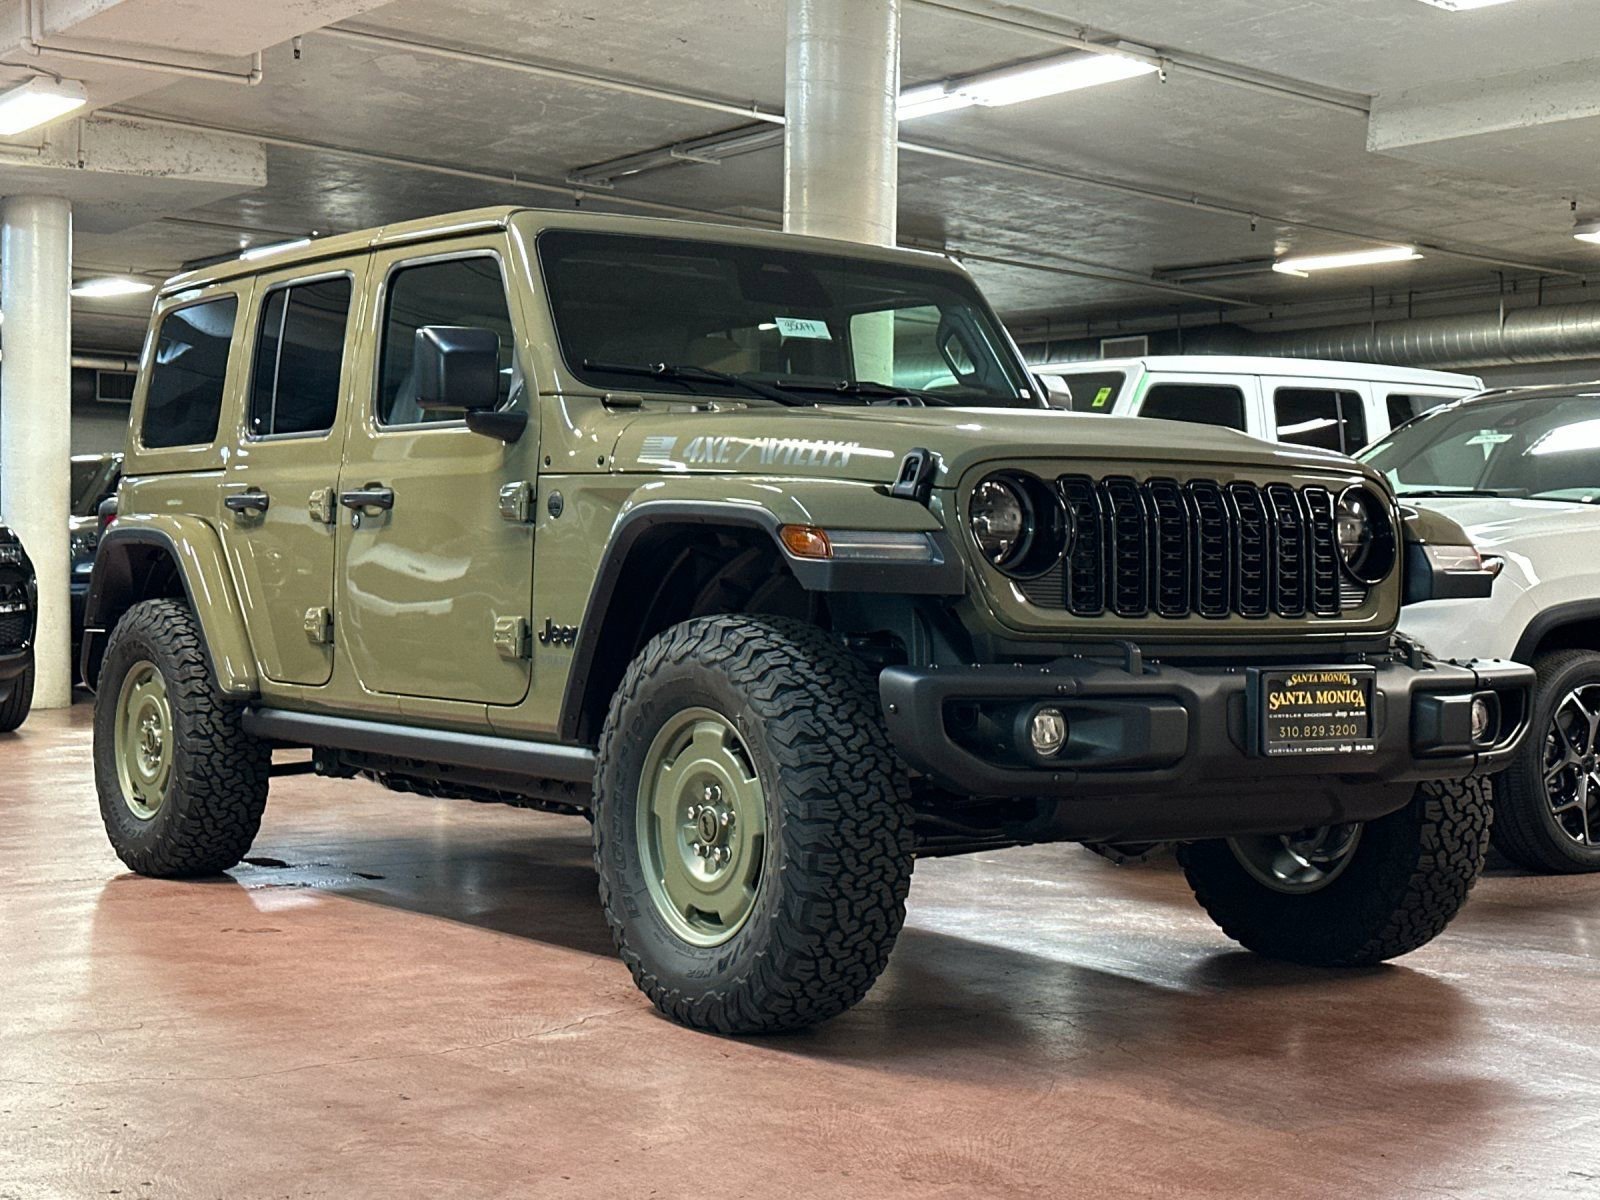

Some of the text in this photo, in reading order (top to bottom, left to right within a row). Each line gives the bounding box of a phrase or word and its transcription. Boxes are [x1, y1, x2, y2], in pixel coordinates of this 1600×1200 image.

[1291, 672, 1351, 686] SANTA MONICA
[1269, 689, 1366, 710] SANTA MONICA
[1279, 723, 1358, 738] 310.829.3200
